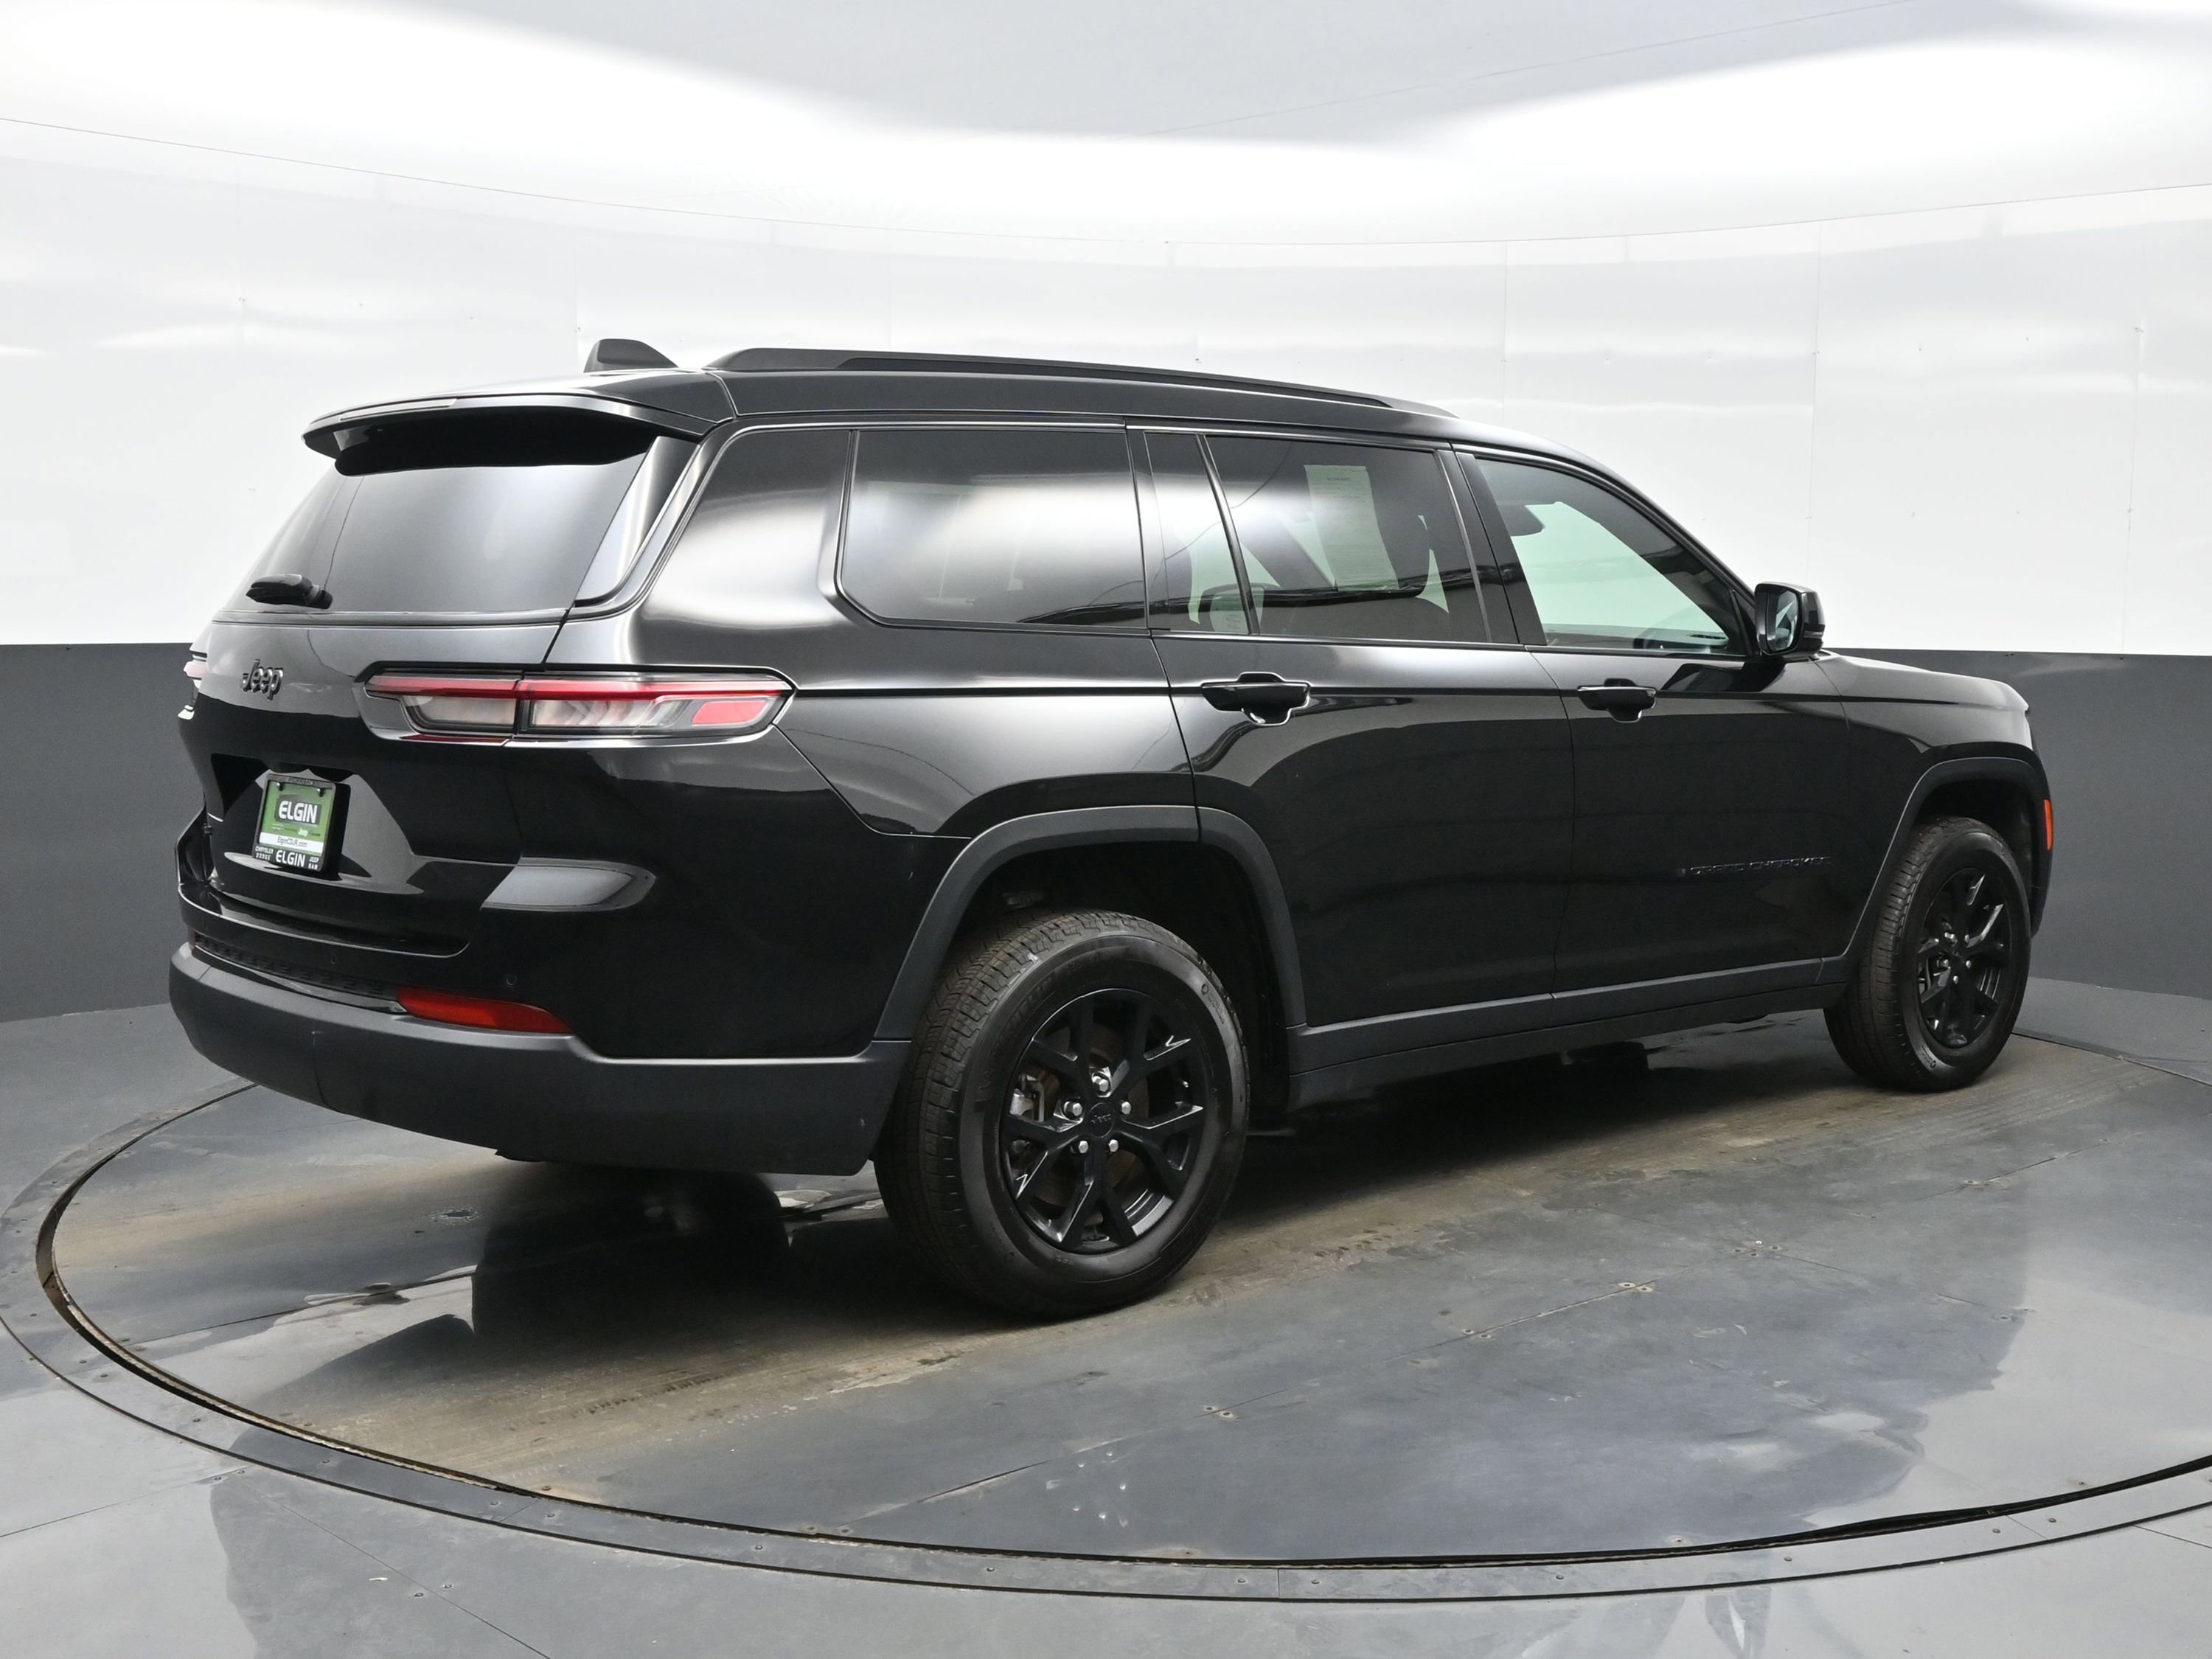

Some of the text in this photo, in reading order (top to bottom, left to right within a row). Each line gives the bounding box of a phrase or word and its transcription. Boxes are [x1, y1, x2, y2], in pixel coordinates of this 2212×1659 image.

[241, 659, 283, 700] Jeep
[279, 800, 318, 824] ELGIN
[255, 846, 274, 855] CHRYSLER
[276, 849, 306, 868] ELGIN
